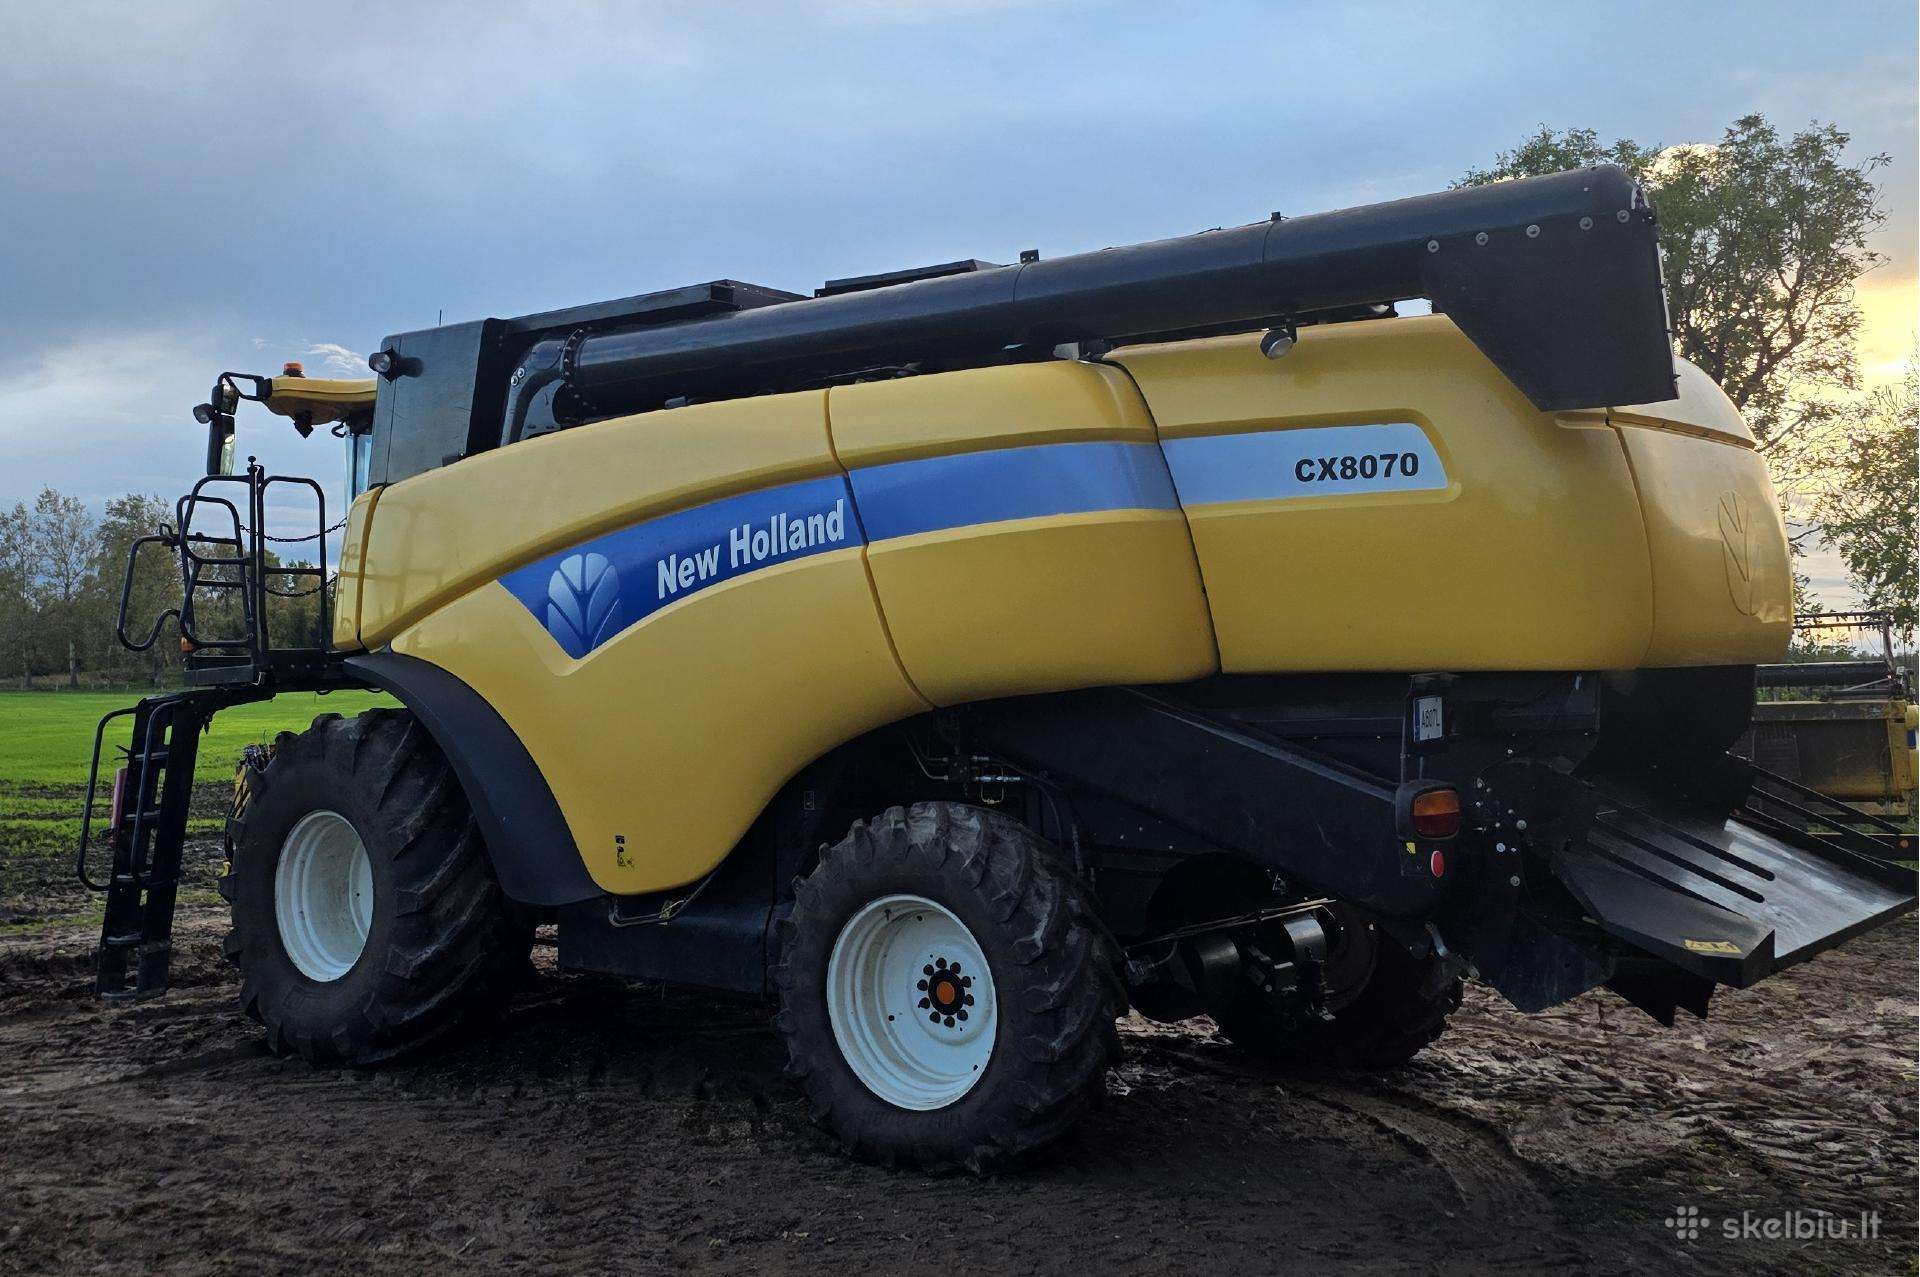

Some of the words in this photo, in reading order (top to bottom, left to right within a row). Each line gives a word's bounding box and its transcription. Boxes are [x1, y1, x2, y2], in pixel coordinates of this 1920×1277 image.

[1294, 452, 1419, 482] CX8070
[656, 543, 721, 600] New
[730, 498, 846, 569] Holland
